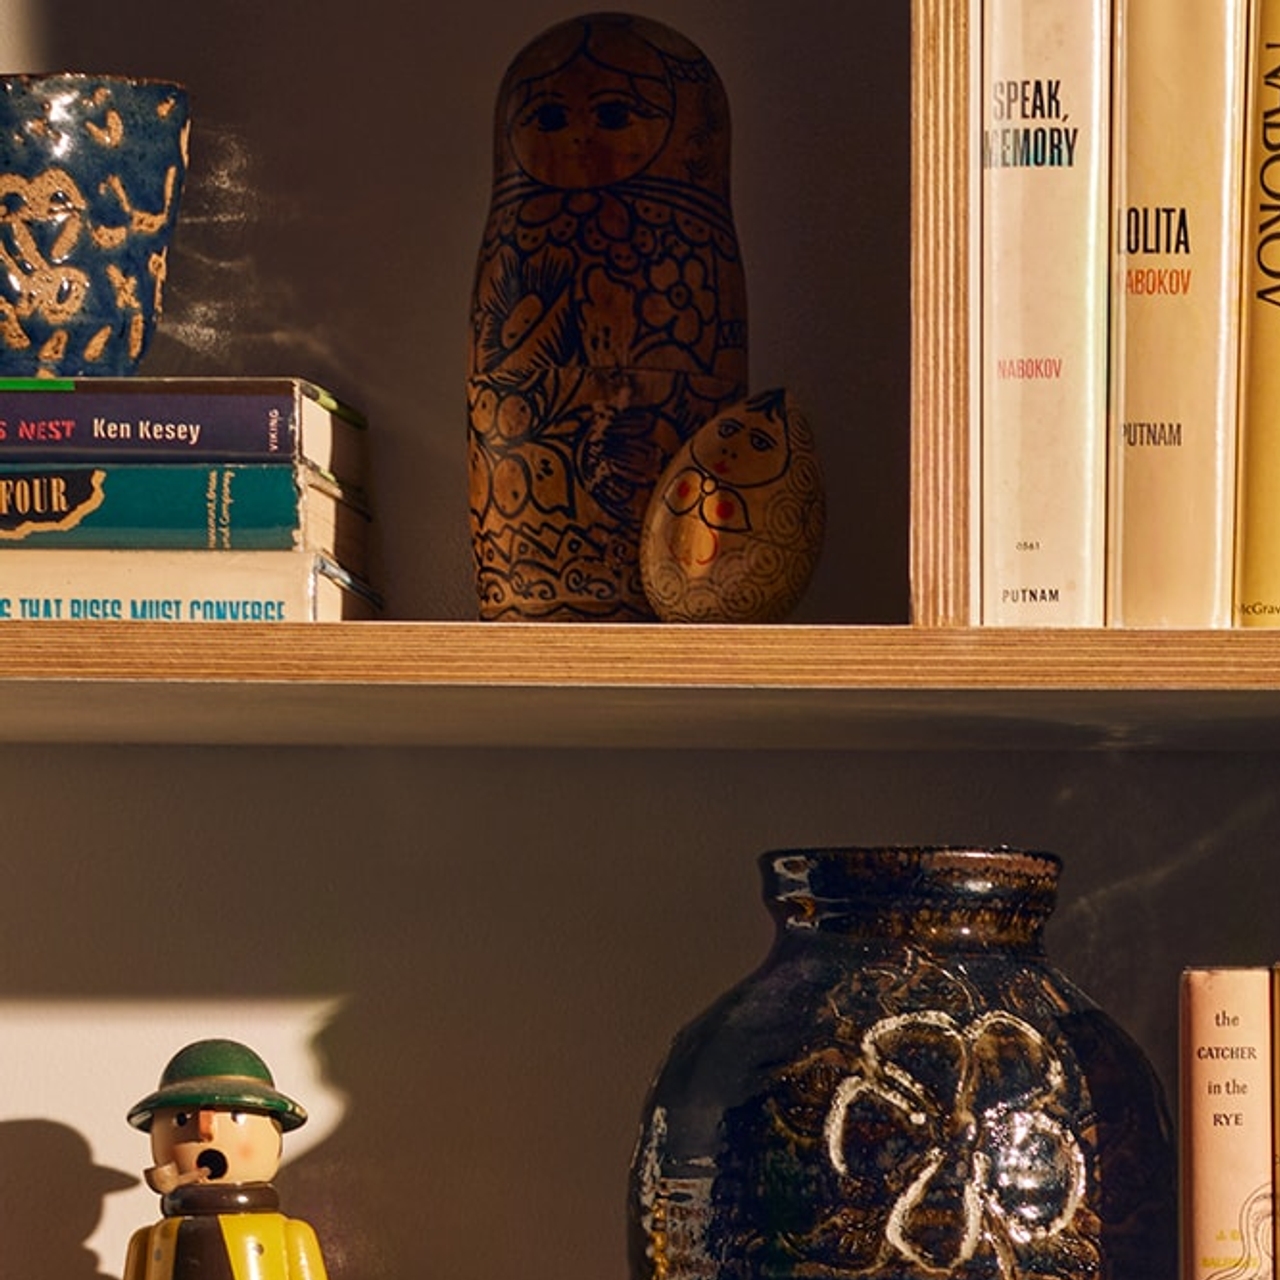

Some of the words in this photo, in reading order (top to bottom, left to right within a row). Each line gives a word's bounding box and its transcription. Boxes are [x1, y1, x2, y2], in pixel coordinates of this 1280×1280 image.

[993, 80, 1069, 123] SPEAK,
[984, 128, 1077, 168] MEMORY
[998, 359, 1062, 379] NABOKOV
[19, 420, 76, 440] NEST
[93, 418, 131, 439] Ken
[139, 420, 200, 445] Kesey
[269, 408, 280, 451] VIKING
[0, 477, 68, 515] FOUR
[1001, 590, 1059, 603] PUTNAM
[19, 599, 62, 620] THAT
[130, 600, 182, 620] MUST
[1215, 1010, 1240, 1027] the
[1196, 1047, 1258, 1060] CATCHER
[1208, 1081, 1222, 1096] in
[1225, 1080, 1249, 1096] the
[1213, 1114, 1244, 1127] RYE
